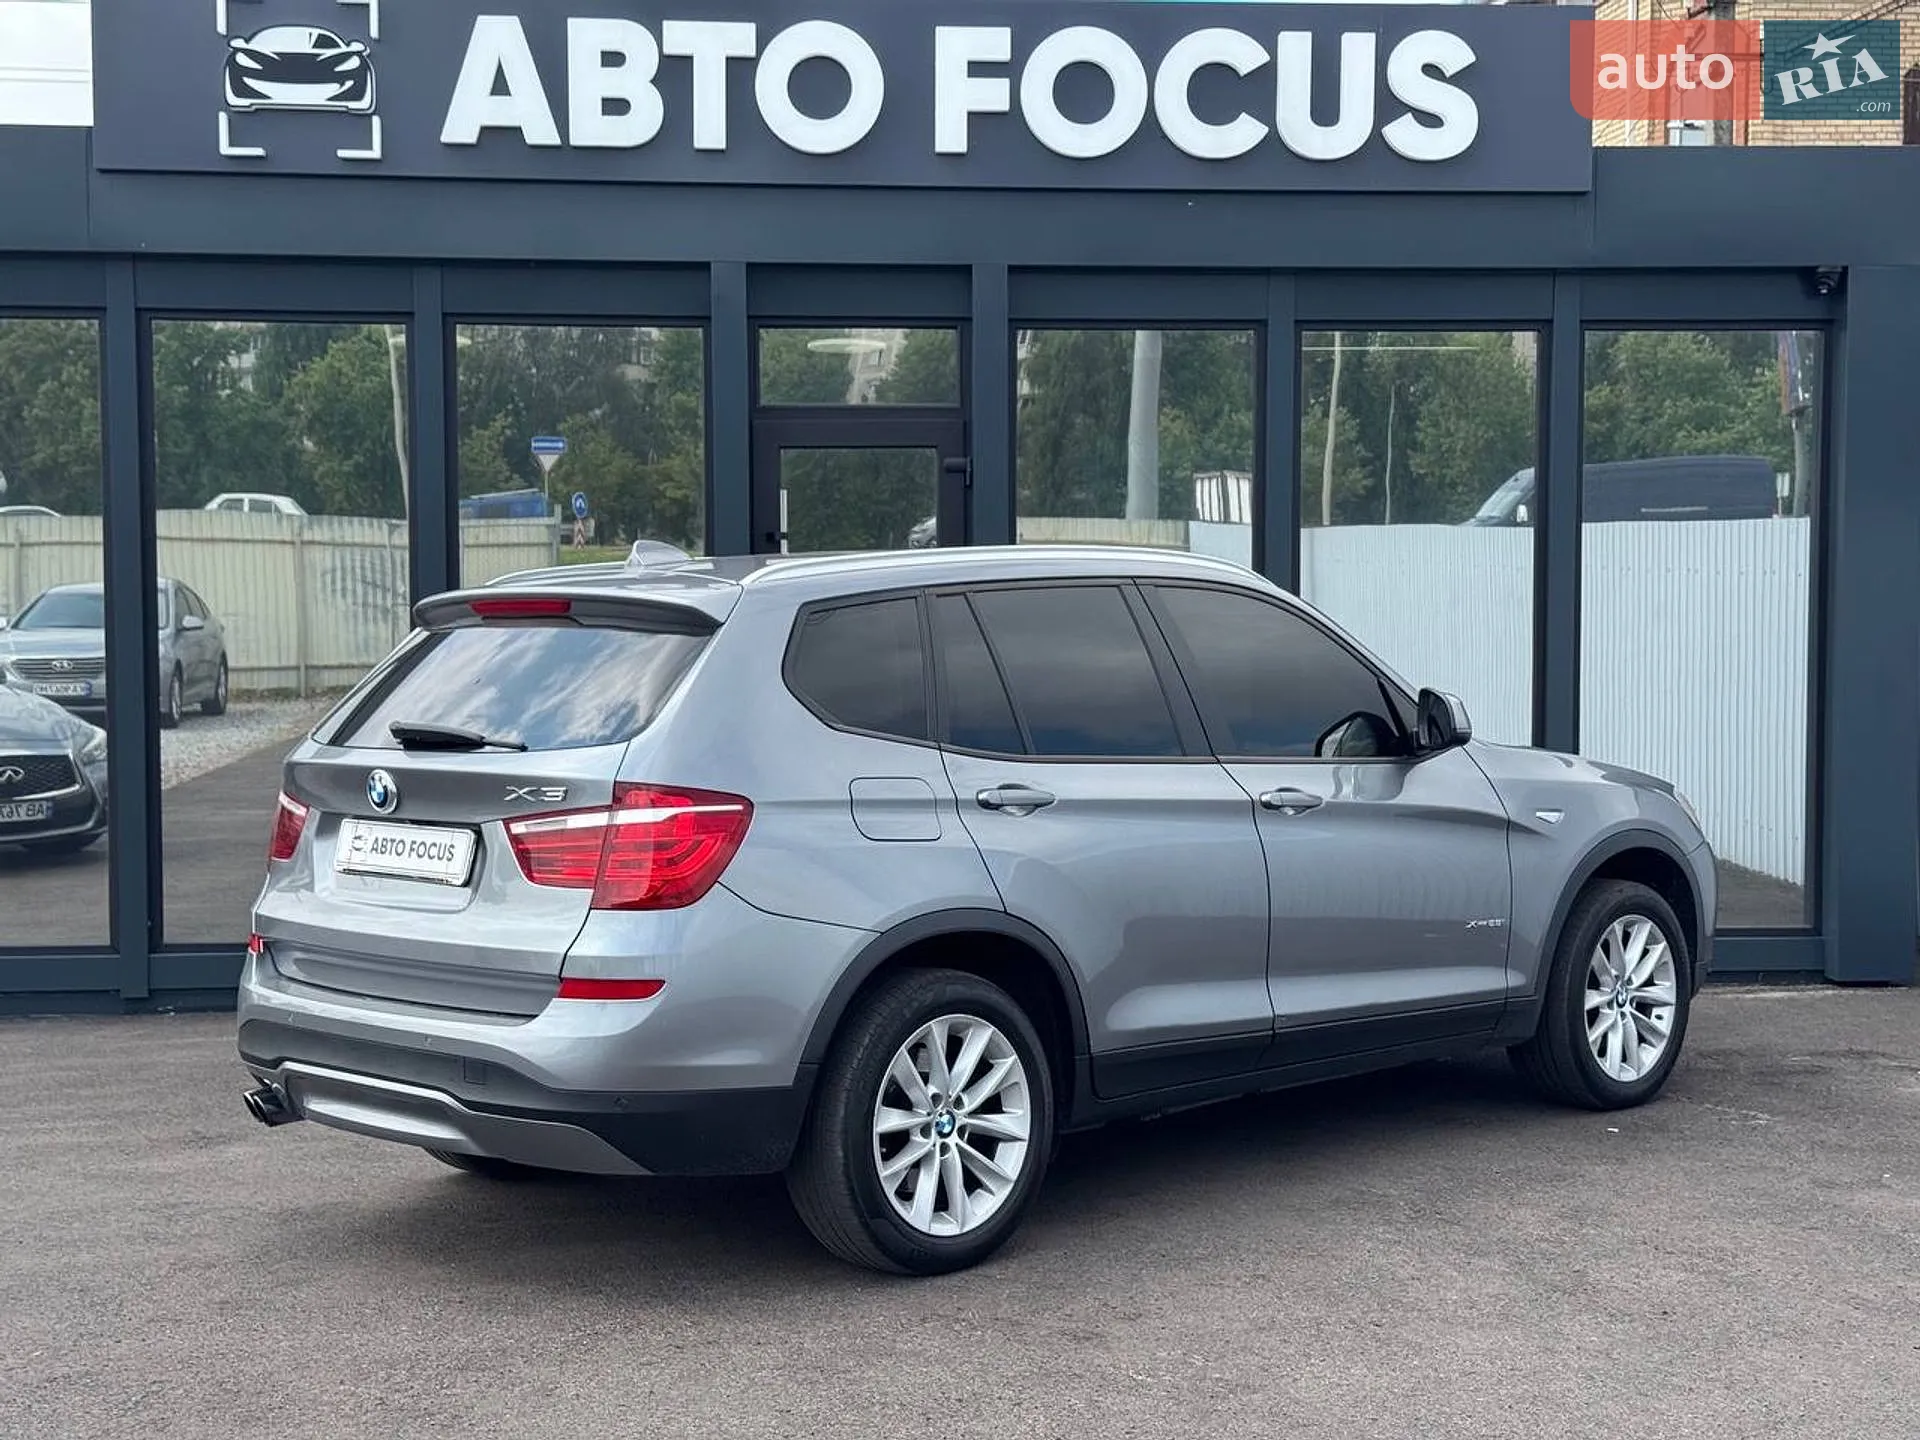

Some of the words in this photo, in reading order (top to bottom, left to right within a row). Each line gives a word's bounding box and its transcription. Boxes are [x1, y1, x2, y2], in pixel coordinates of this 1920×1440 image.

[440, 15, 885, 155] АВТО
[935, 25, 1479, 161] FOCUS
[503, 784, 568, 802] X3
[370, 836, 407, 857] АВТО
[408, 840, 456, 862] FOCUS
